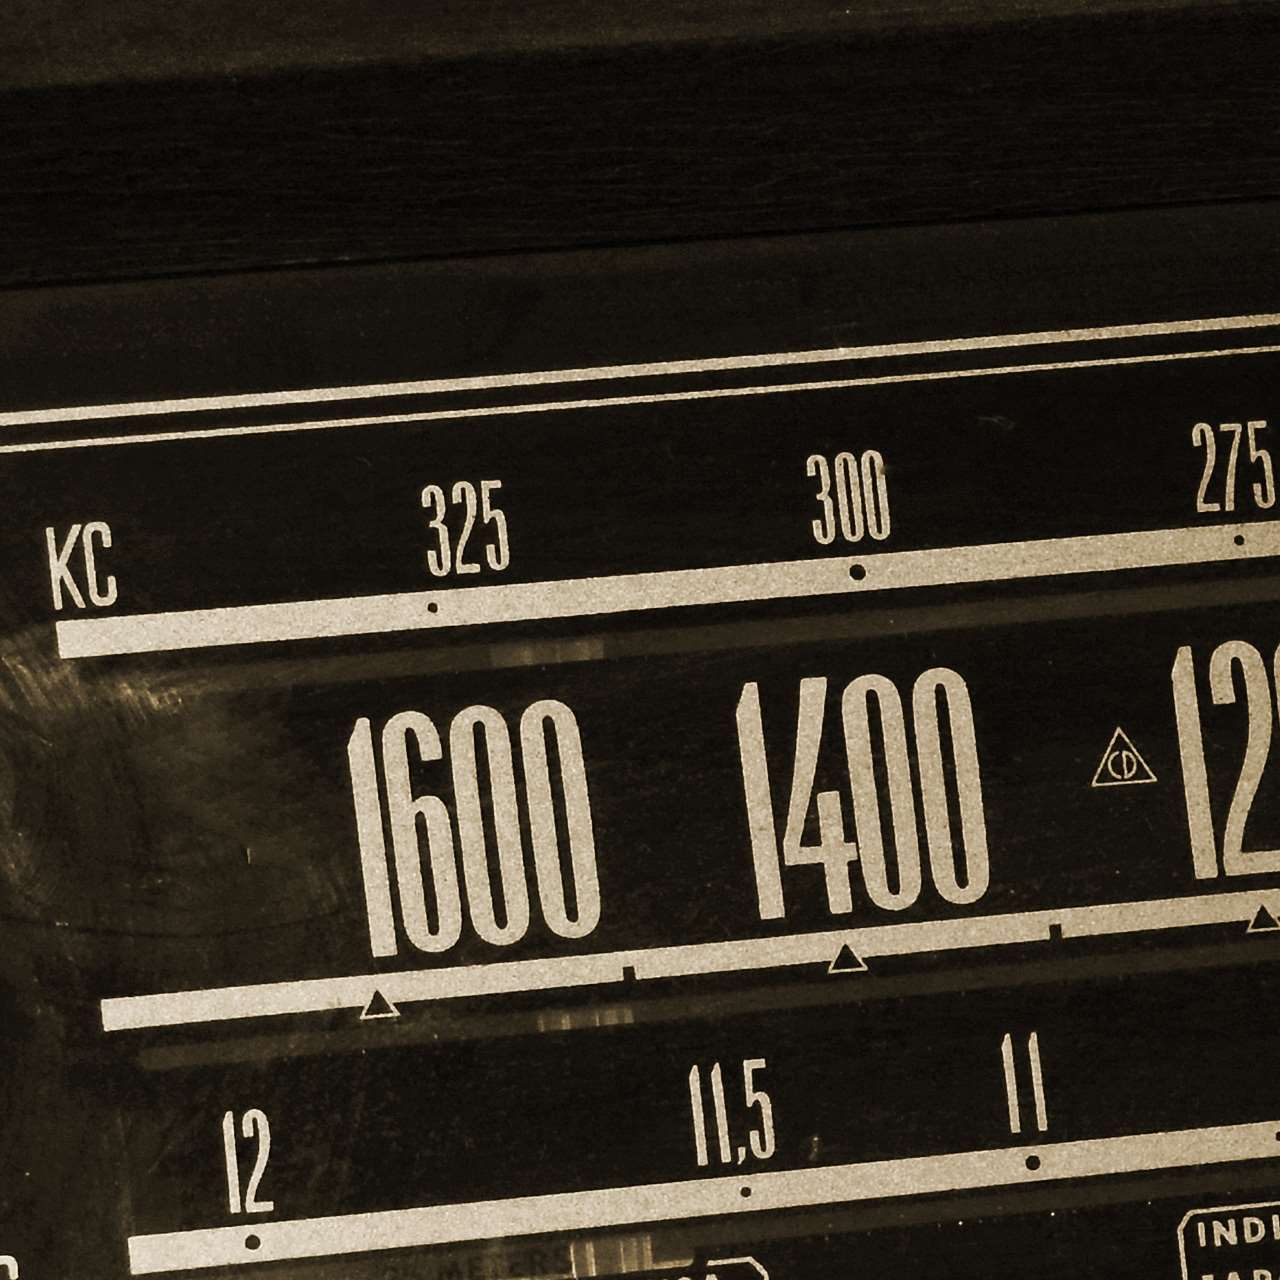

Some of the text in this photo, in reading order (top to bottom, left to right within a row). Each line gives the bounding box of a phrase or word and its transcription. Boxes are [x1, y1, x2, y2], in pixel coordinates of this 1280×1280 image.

[807, 450, 890, 544] 300
[1192, 420, 1275, 512] 275
[46, 522, 117, 610] KC
[421, 480, 509, 576] 325
[347, 700, 600, 957] 1600
[736, 667, 989, 919] 1400
[689, 1059, 775, 1166] 11,5
[1001, 1032, 1047, 1133] 11
[223, 1109, 274, 1213] 12
